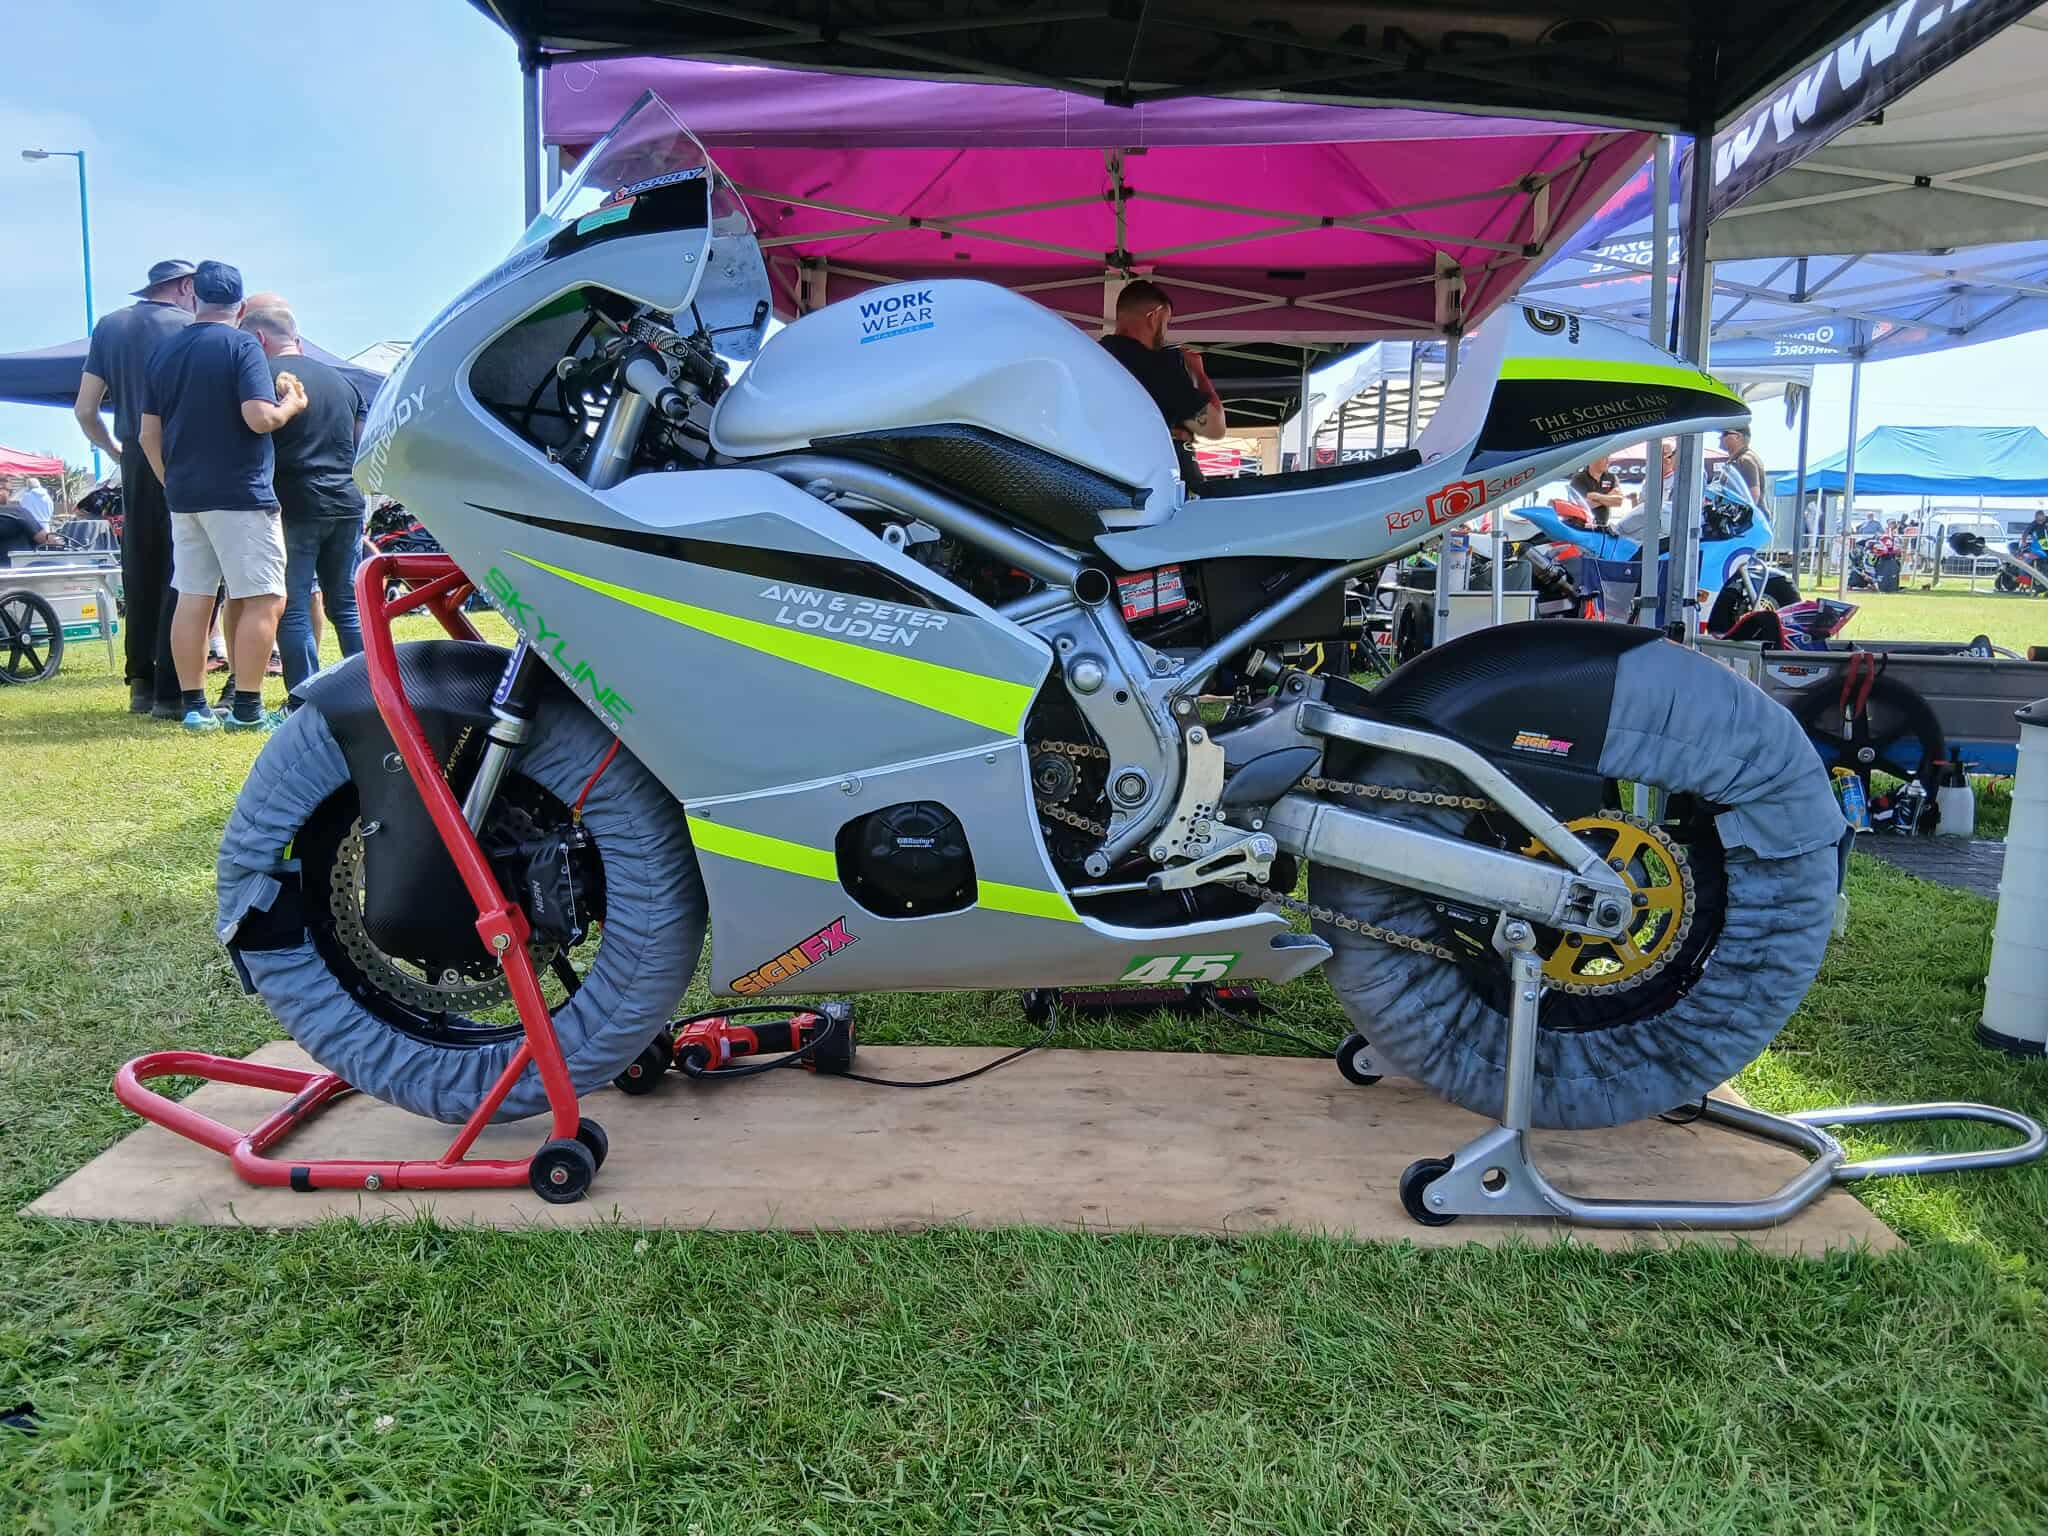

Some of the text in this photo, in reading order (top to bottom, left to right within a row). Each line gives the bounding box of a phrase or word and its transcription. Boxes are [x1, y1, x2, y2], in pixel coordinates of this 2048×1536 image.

[860, 290, 934, 318] WORK
[862, 307, 932, 334] WEAR
[1530, 393, 1668, 431] THE SCENIC INN
[1551, 431, 1574, 444] BAR
[1576, 423, 1600, 438] AND
[760, 584, 949, 632] ANN & PETER
[775, 606, 919, 647] LOUDEN
[484, 566, 635, 725] SKYLINE
[560, 671, 577, 690] NI
[587, 698, 620, 732] LTD
[1120, 955, 1235, 983] 45
